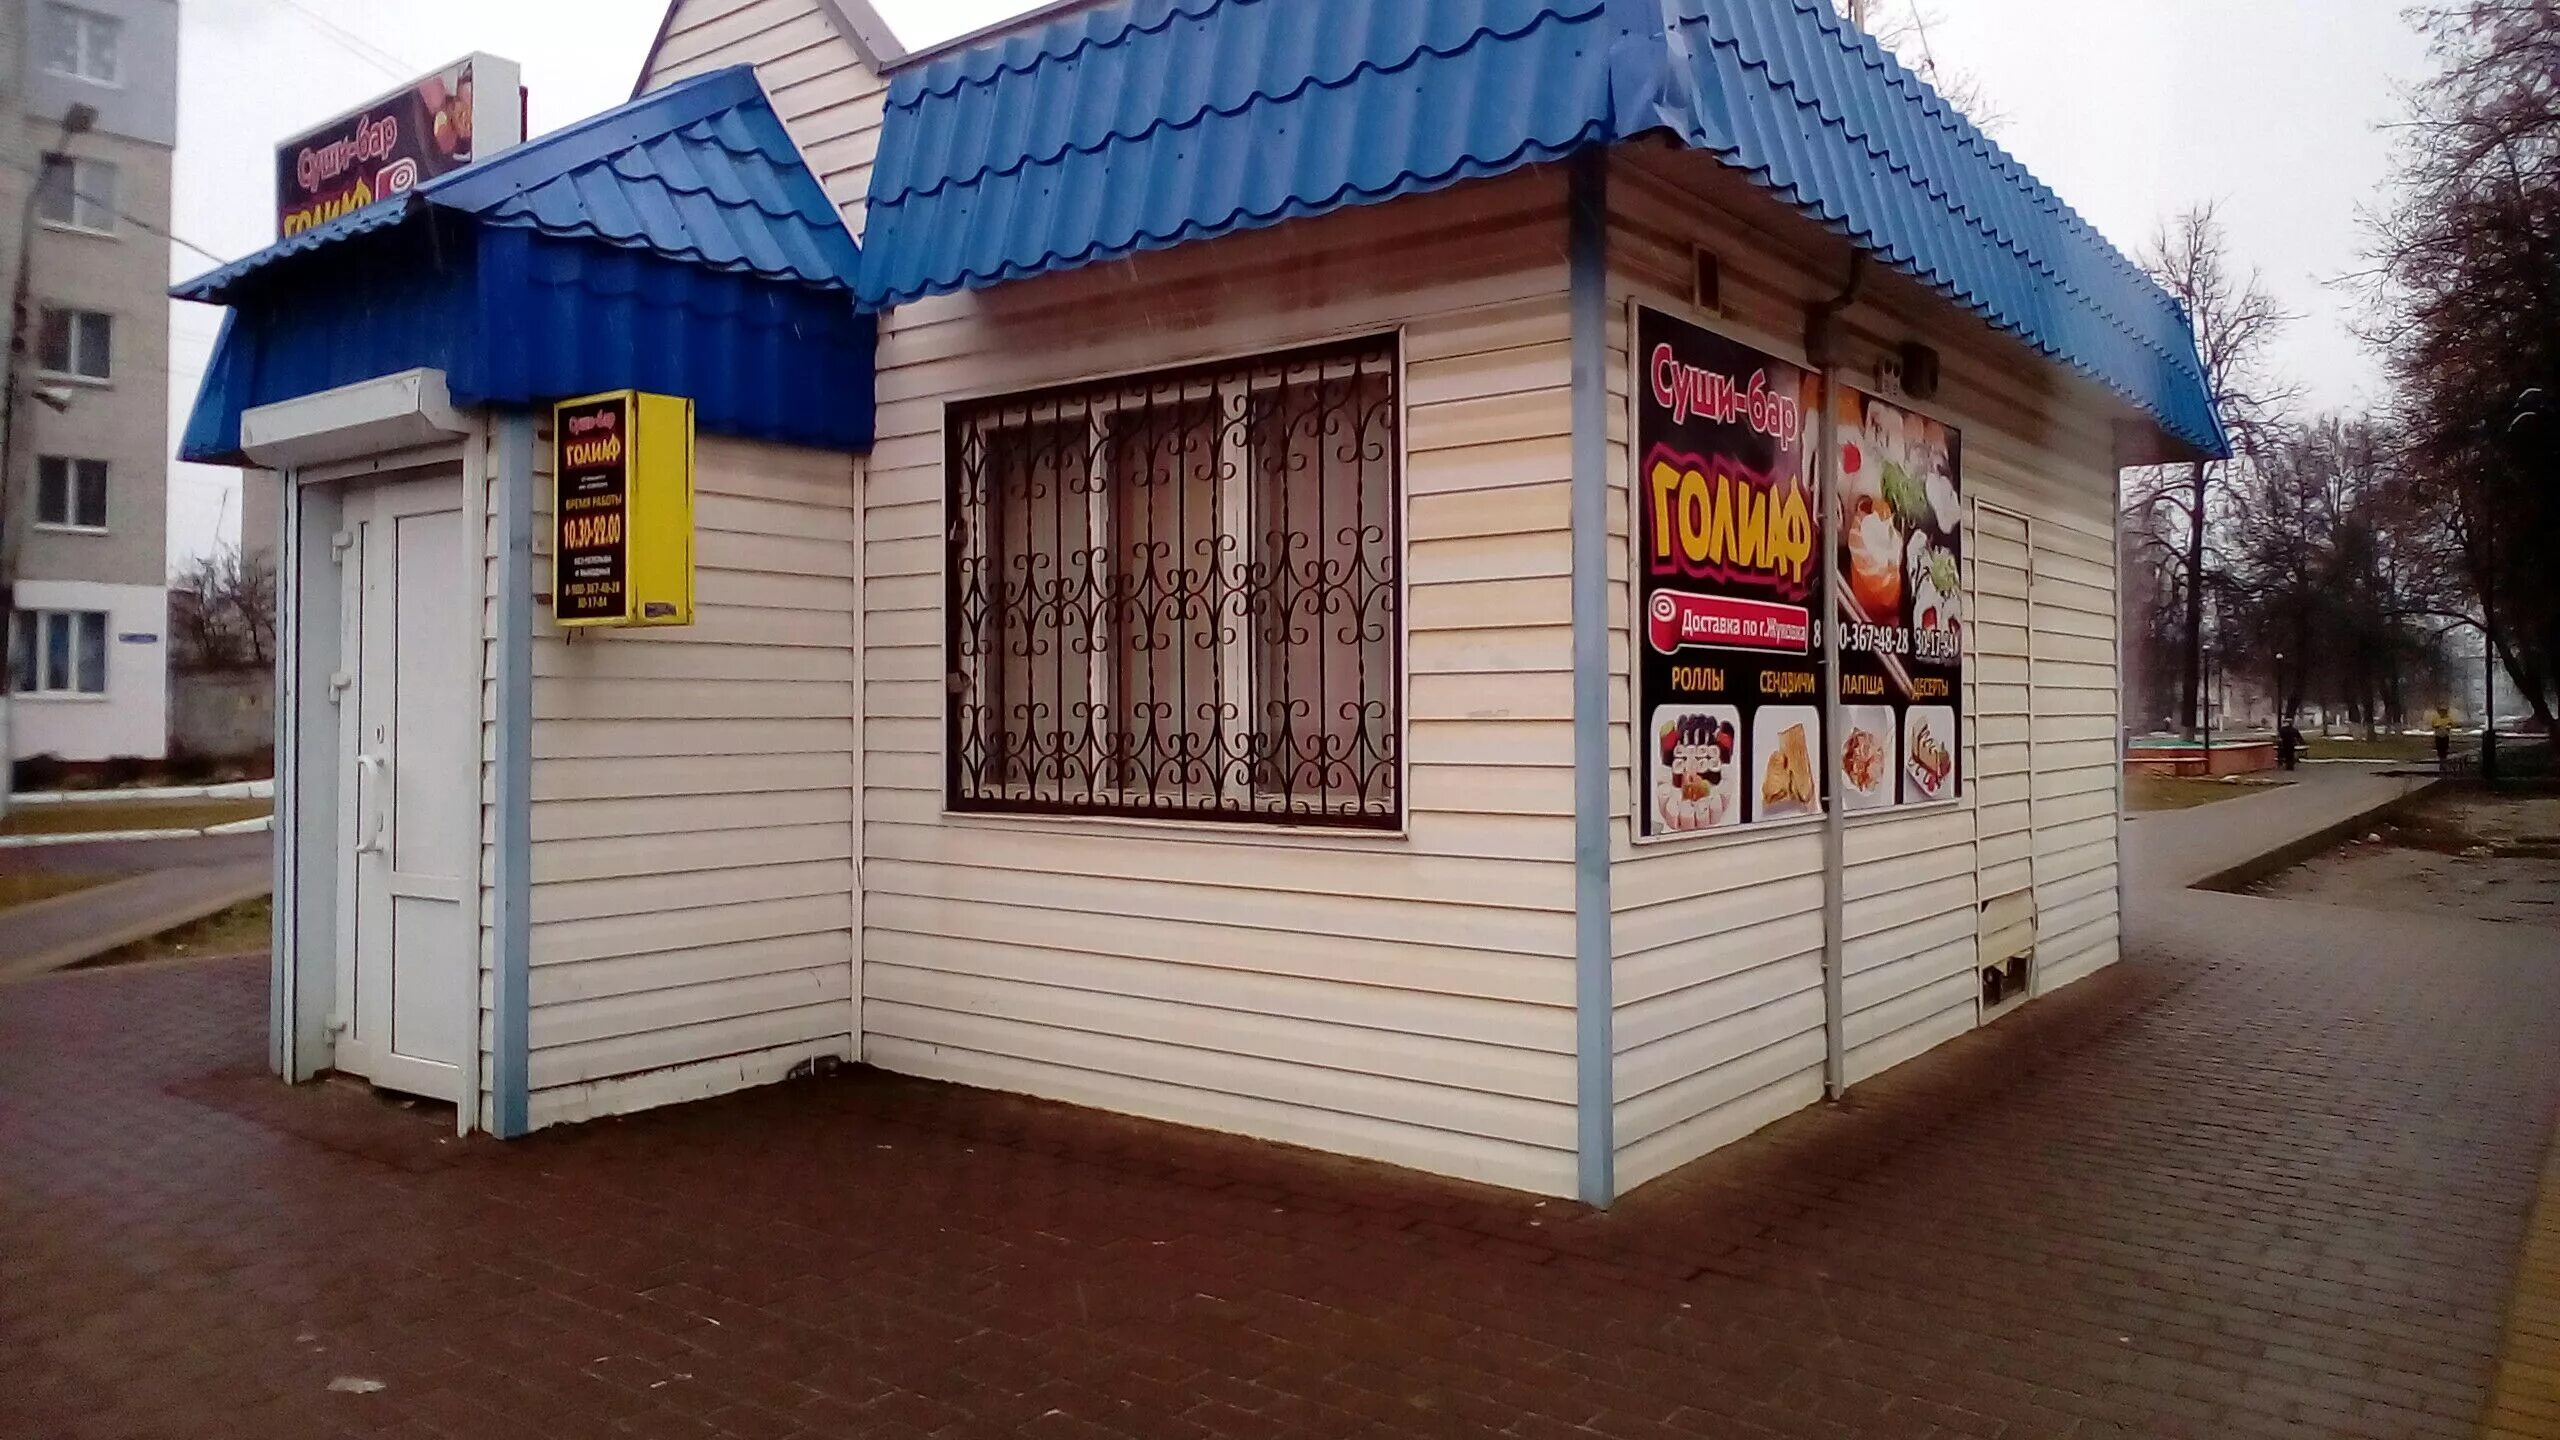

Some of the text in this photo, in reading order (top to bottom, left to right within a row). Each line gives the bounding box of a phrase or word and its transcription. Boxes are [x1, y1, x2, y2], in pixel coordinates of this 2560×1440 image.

[298, 114, 397, 193] Суши-бар
[1651, 343, 1798, 451] Суши-бар
[566, 433, 621, 467] ГОЛИАФ
[1651, 460, 1811, 583] ГОЛИАФ
[1681, 609, 1740, 637] Доставка
[1742, 620, 1757, 637] по
[1671, 665, 1724, 692] РОЛЛЫ
[1759, 670, 1816, 698] СЕНДВИЧИ
[1842, 674, 1884, 695] ЛАПША
[1912, 677, 1949, 700] ДЕСЕРТЫ
